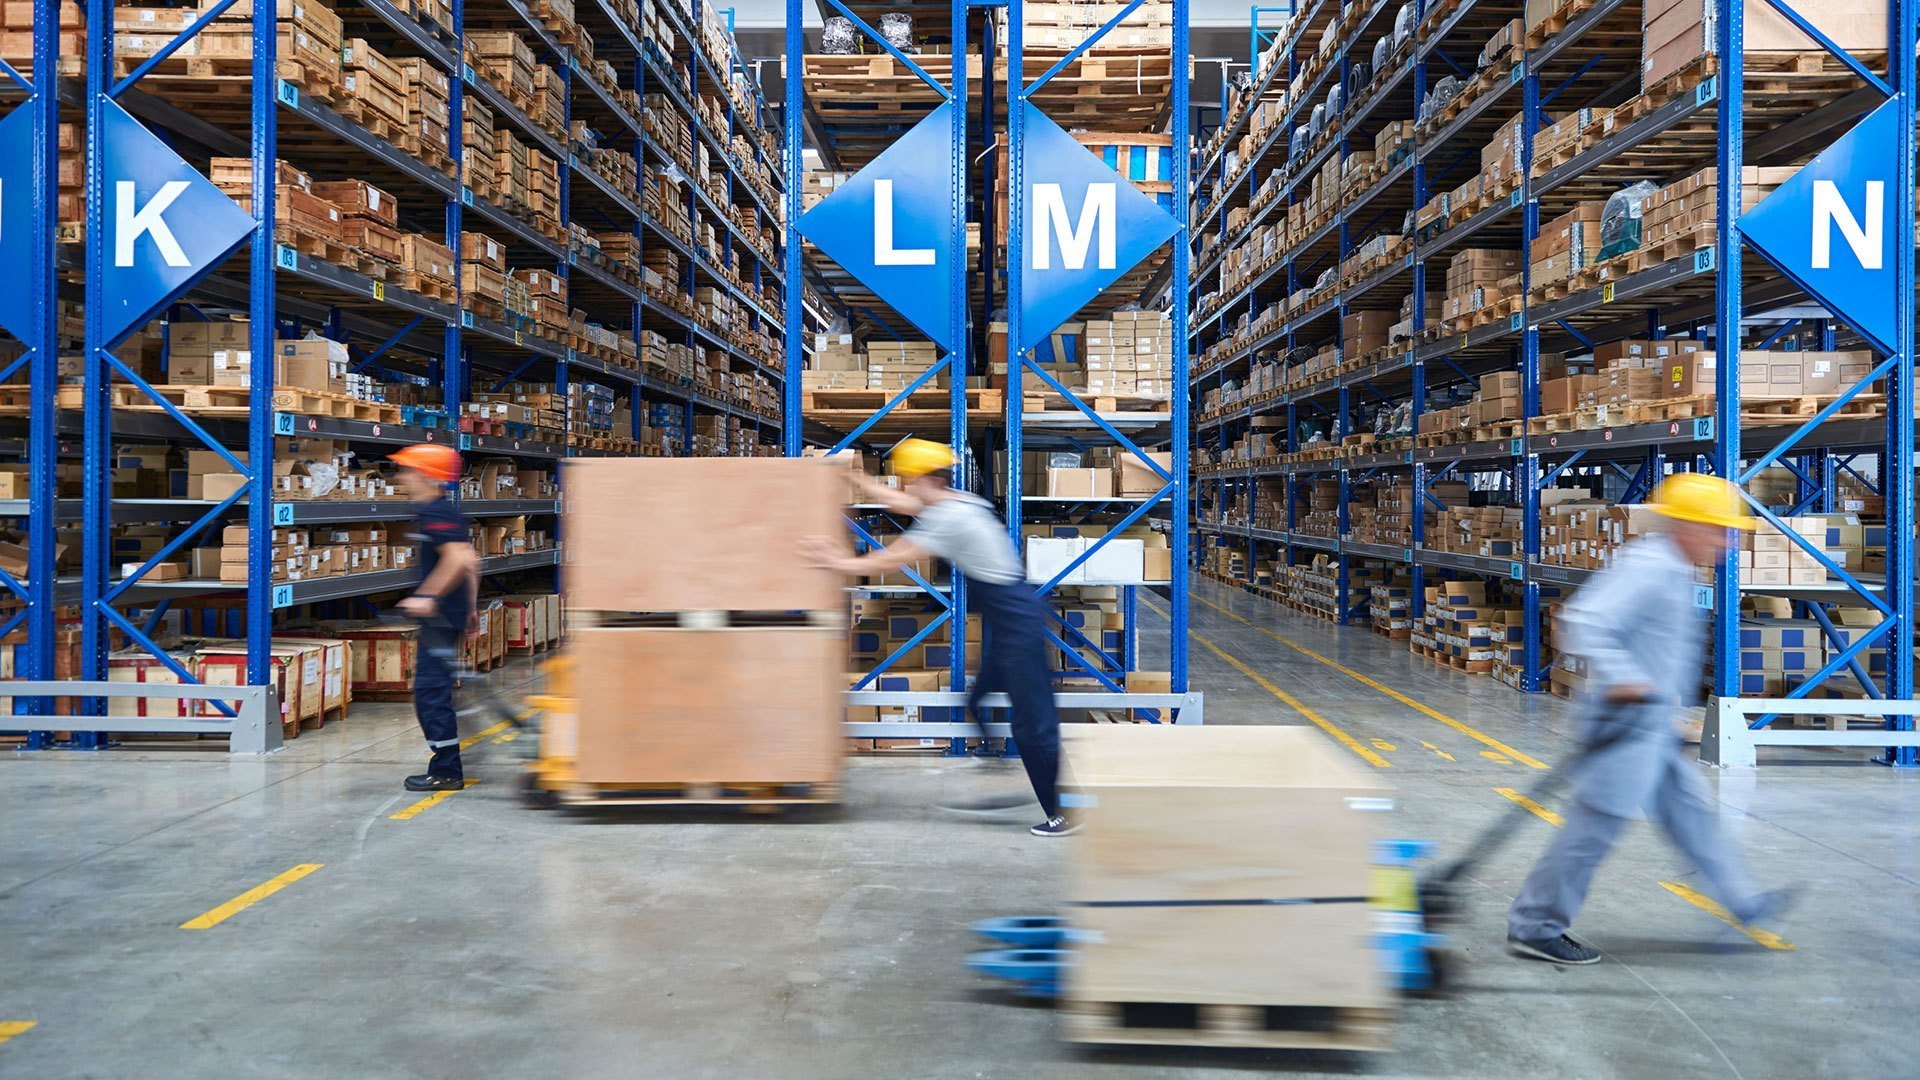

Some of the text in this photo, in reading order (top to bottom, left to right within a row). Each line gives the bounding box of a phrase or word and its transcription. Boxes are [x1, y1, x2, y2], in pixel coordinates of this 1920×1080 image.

[284, 84, 294, 103] 04
[1701, 82, 1711, 101] 04
[116, 182, 191, 266] K
[875, 180, 935, 264] L
[1033, 183, 1115, 269] M
[1812, 181, 1883, 268] N
[283, 249, 293, 267] 03
[1699, 252, 1709, 269] 03
[376, 283, 383, 299] 01
[1605, 286, 1612, 300] 01
[280, 415, 291, 432] 02
[1698, 420, 1709, 436] 02
[279, 506, 290, 522] d2
[278, 588, 287, 605] d1
[1698, 589, 1707, 606] d1
